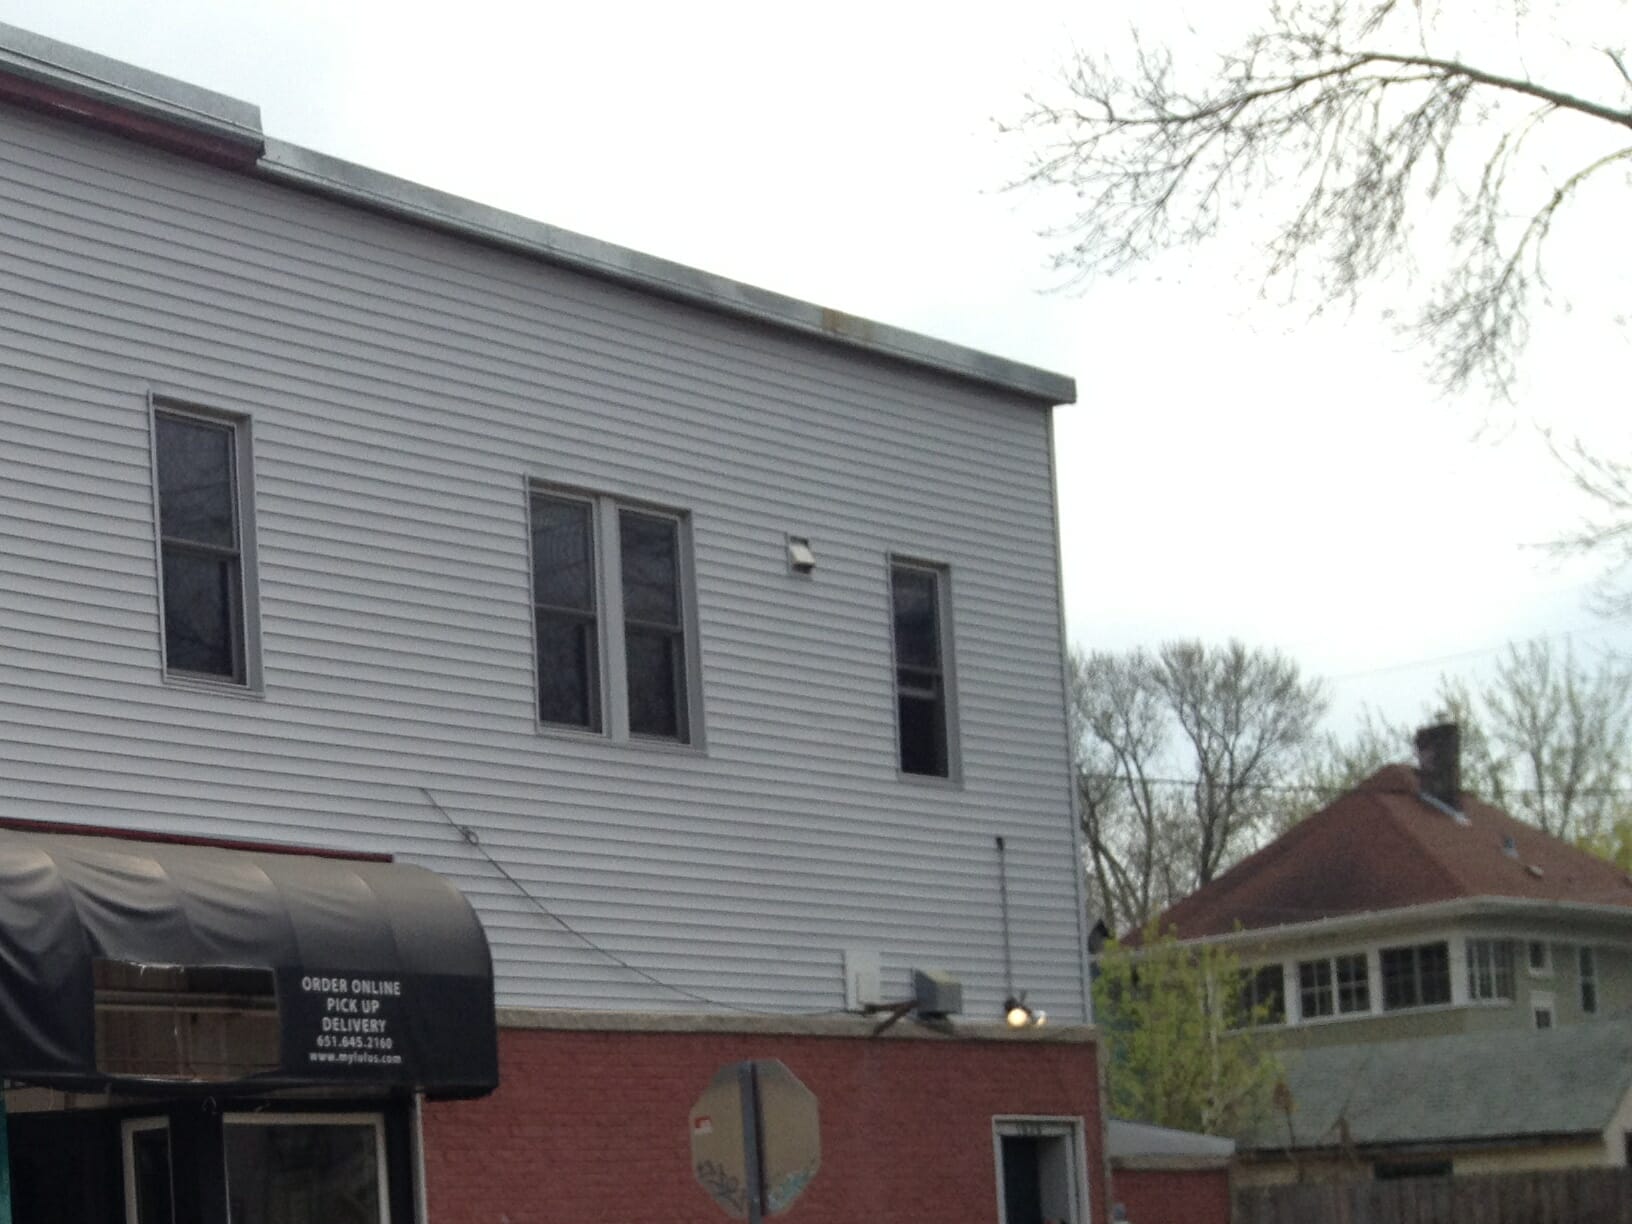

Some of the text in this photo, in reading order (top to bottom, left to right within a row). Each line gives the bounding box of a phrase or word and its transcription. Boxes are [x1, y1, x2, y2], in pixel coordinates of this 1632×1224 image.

[301, 976, 401, 996] ORDER ONLINE
[326, 997, 380, 1014] PICK UP
[321, 1016, 386, 1033] DELIVERY
[316, 1035, 393, 1050] 651.645.2160
